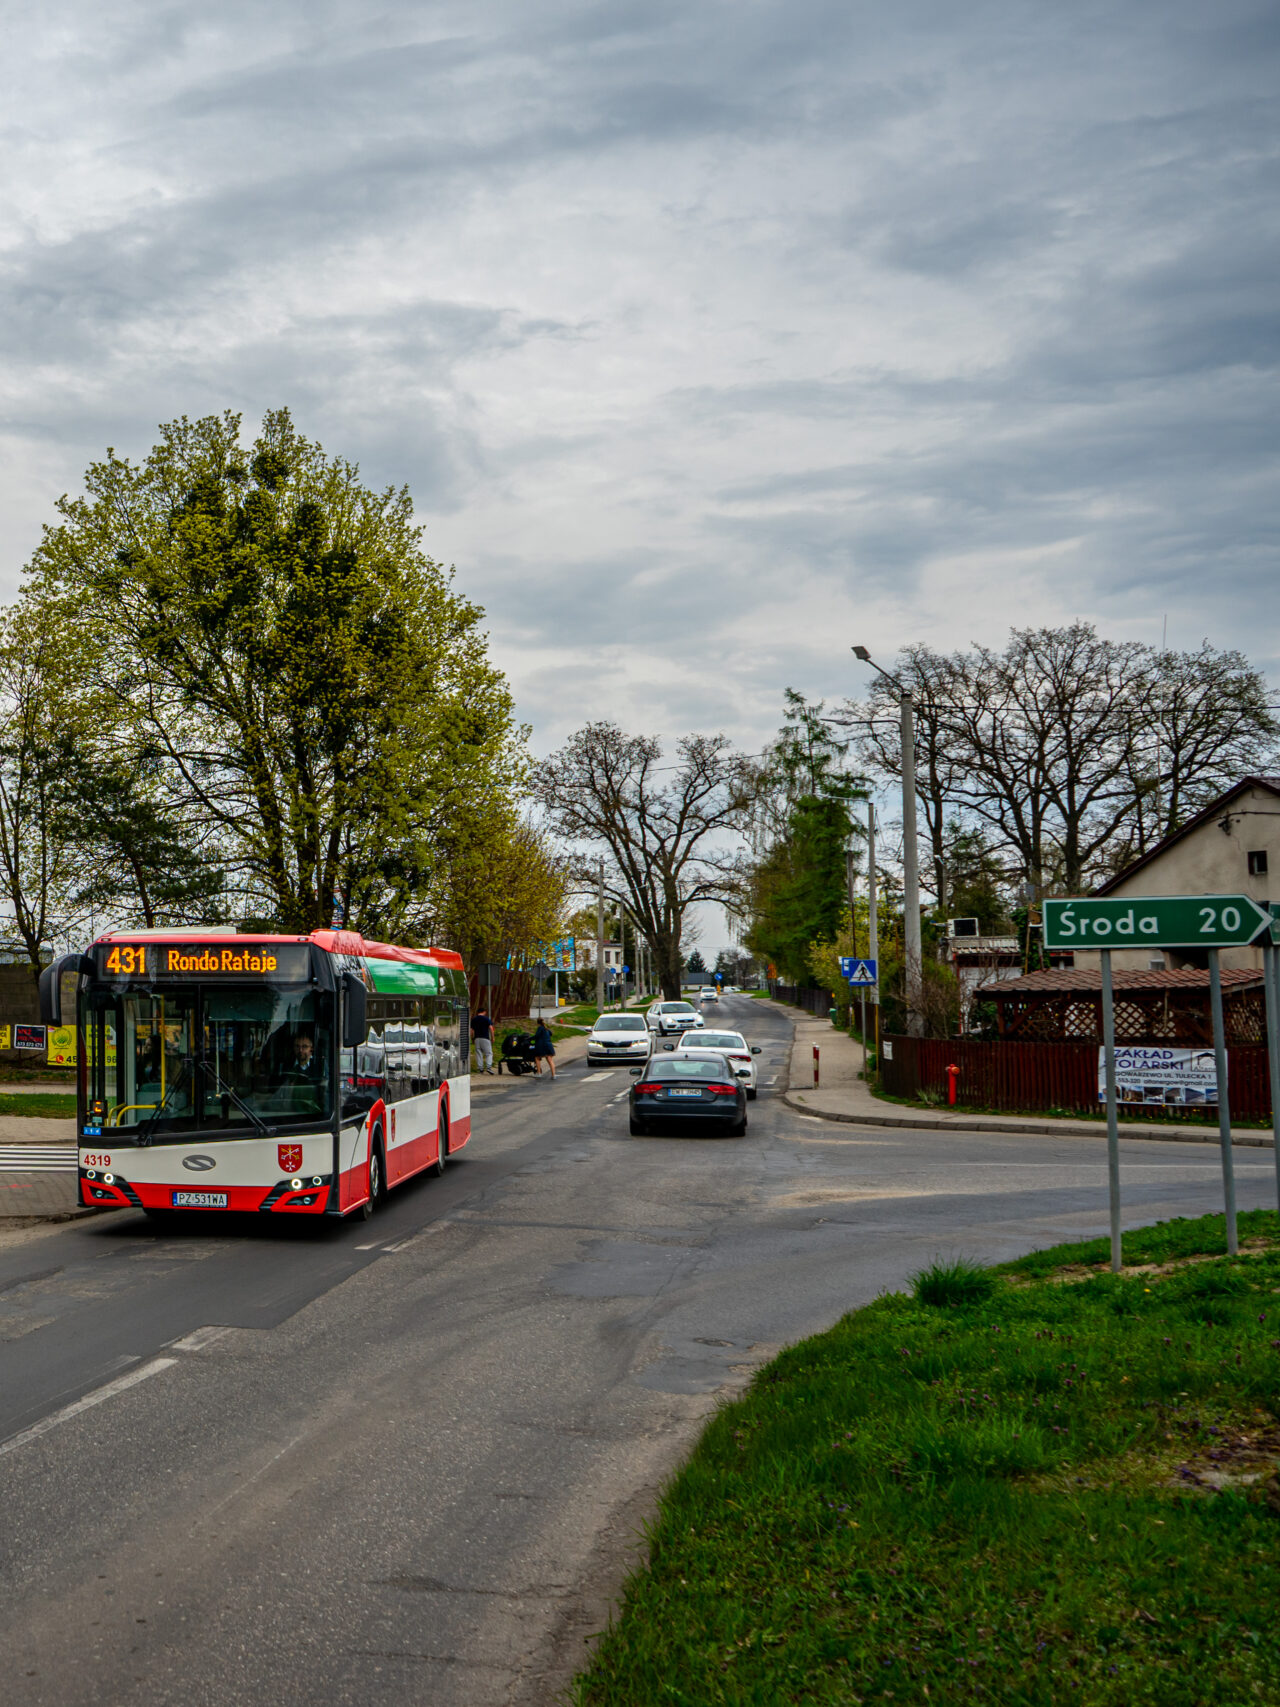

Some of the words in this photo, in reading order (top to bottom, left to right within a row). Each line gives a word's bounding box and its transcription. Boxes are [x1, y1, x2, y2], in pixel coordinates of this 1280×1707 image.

[1058, 903, 1160, 936] Środa
[1198, 906, 1241, 933] 20
[106, 946, 146, 974] 431
[168, 950, 219, 971] Rondo
[221, 950, 277, 973] Rataje
[1113, 1049, 1174, 1060] ZAKŁAD
[1106, 1059, 1184, 1070] TOLARSKI
[83, 1154, 112, 1167] 4319
[178, 1193, 192, 1204] PZ
[194, 1194, 225, 1205] 531WA
